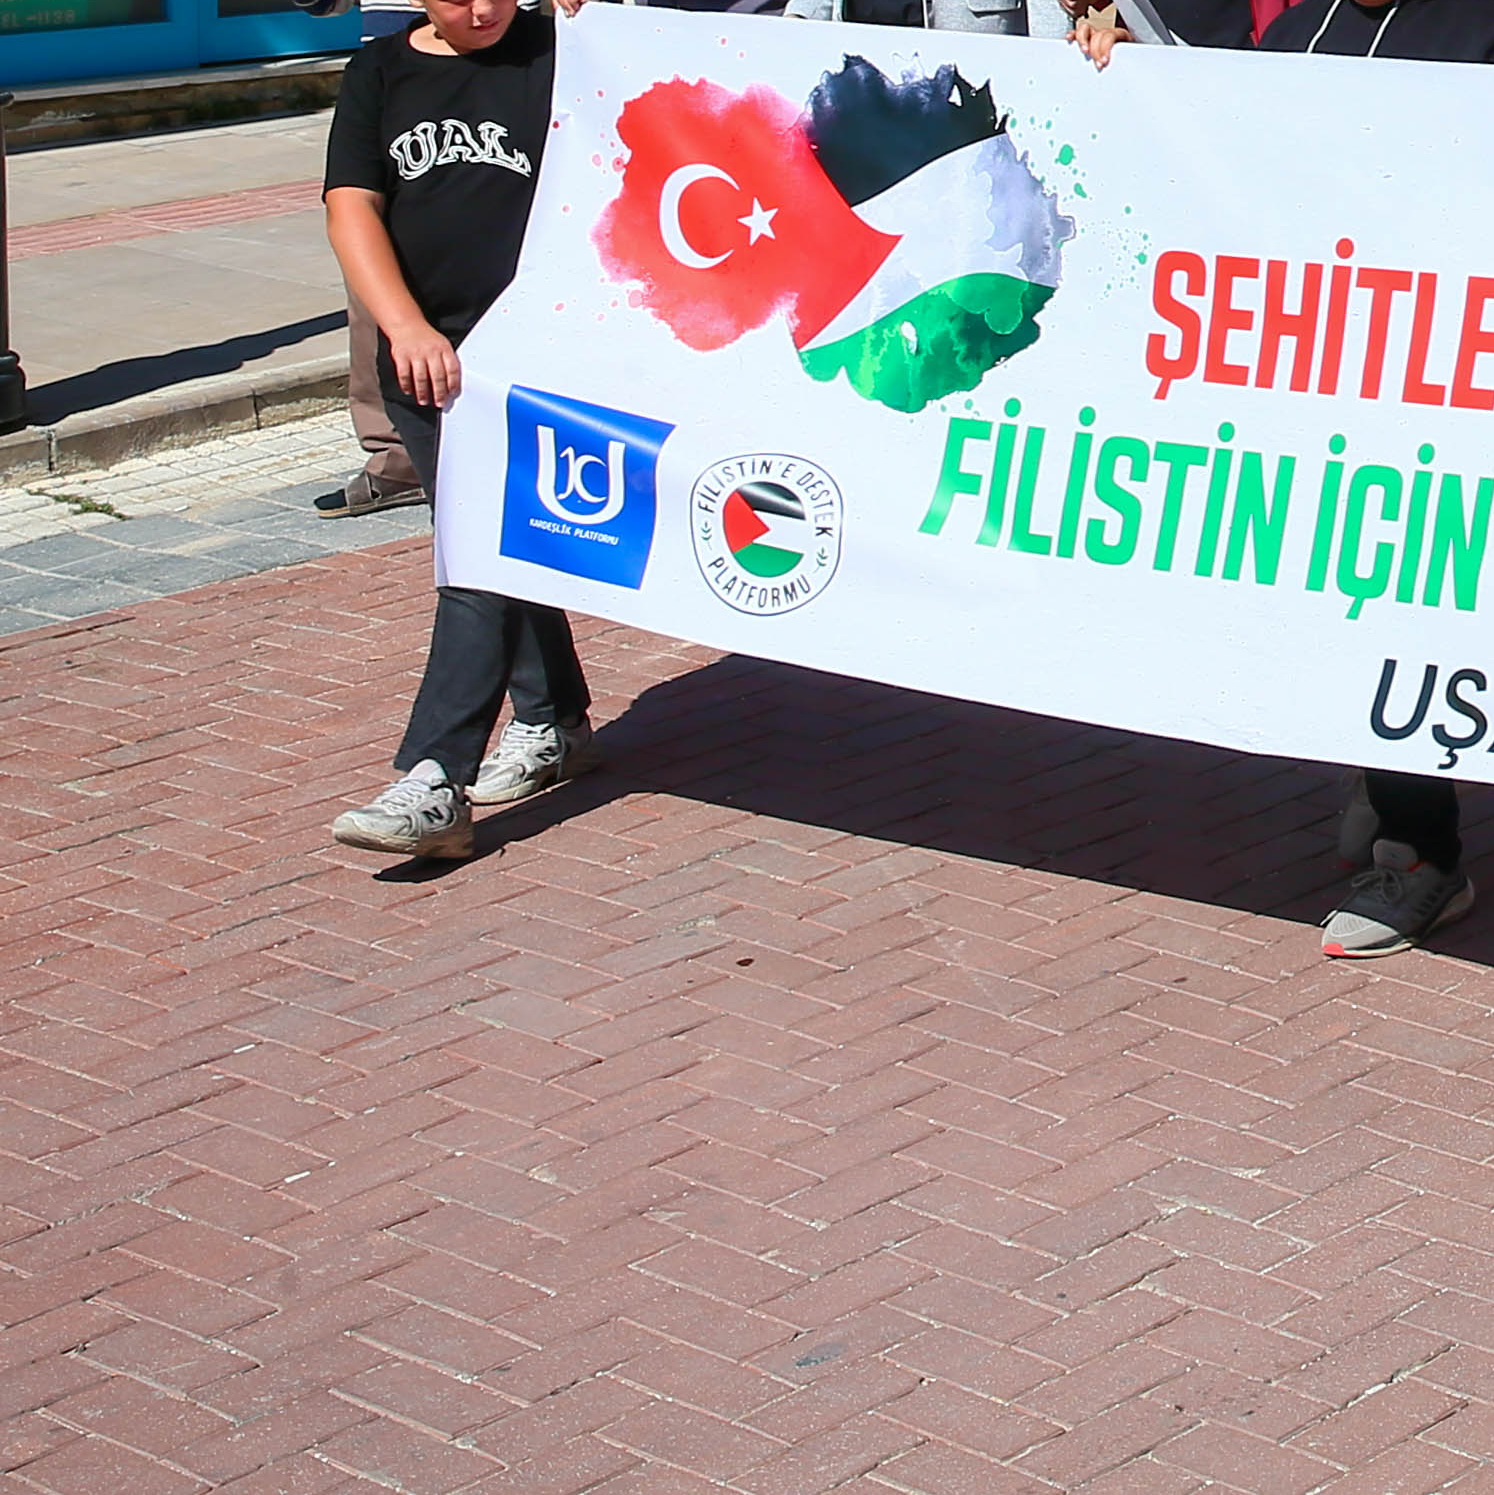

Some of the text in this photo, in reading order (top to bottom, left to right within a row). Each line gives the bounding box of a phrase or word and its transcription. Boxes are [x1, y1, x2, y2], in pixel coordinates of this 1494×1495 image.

[390, 118, 532, 180] UAL
[796, 471, 834, 539] DESTEK
[919, 397, 1297, 586] FİLİSTİN
[707, 556, 811, 608] PLATFORMU
